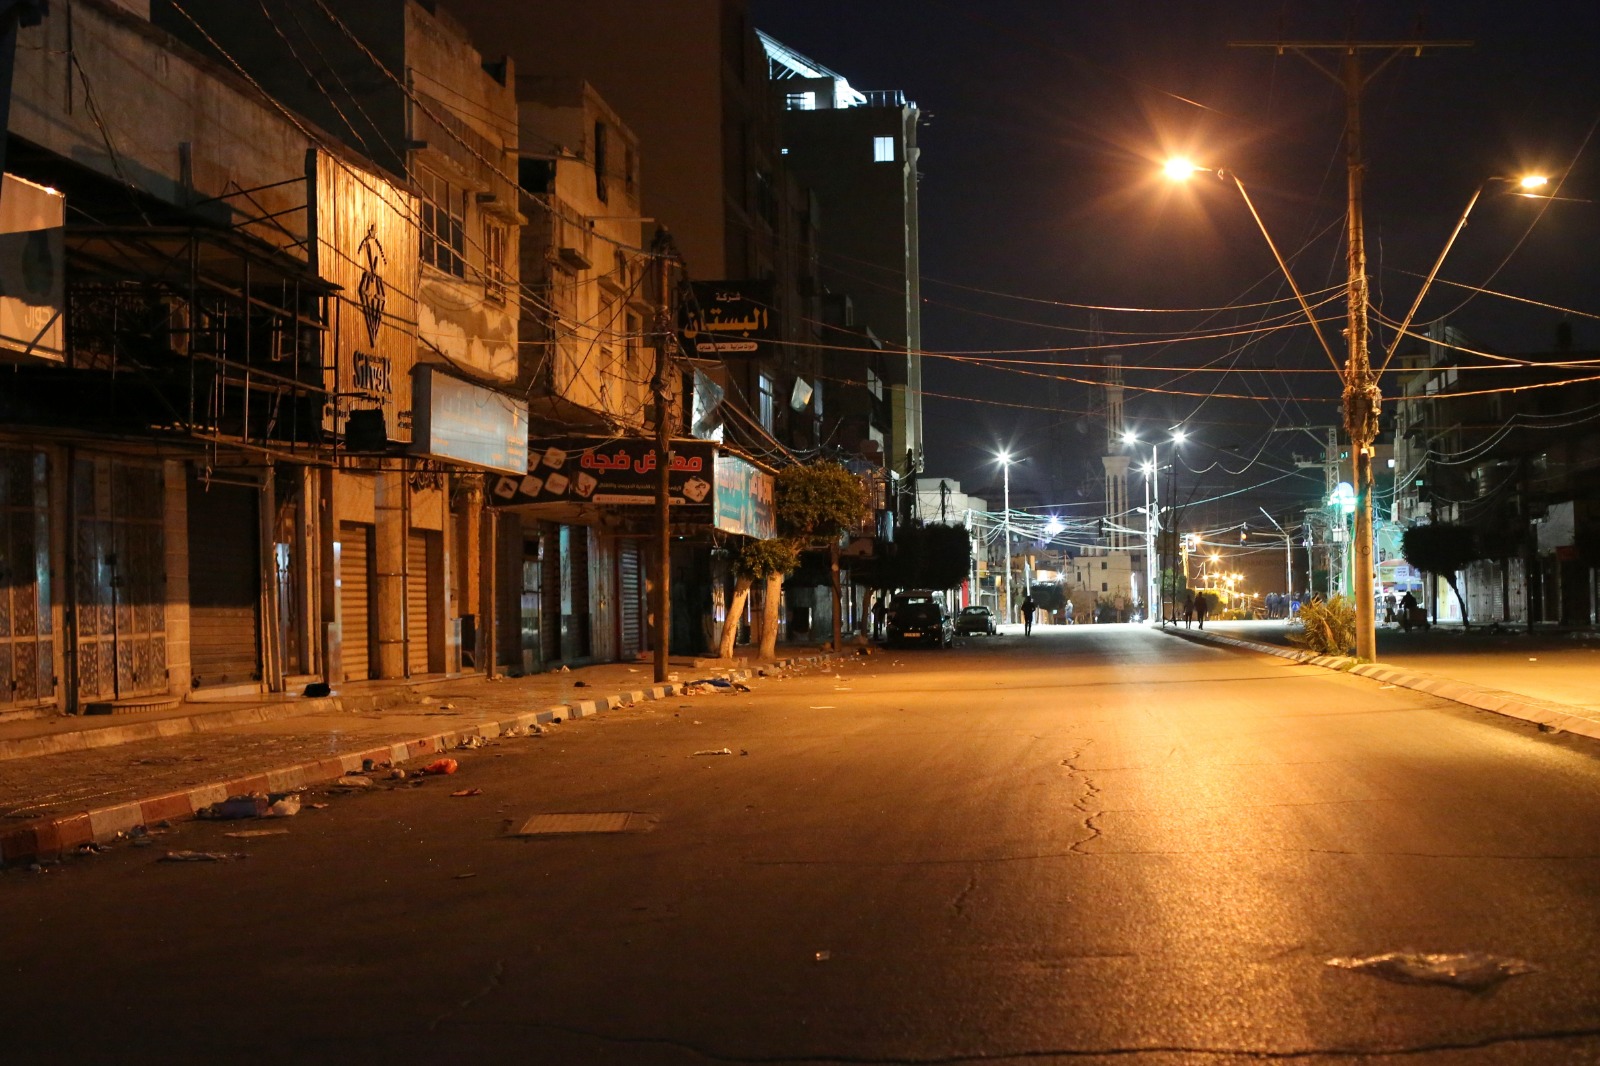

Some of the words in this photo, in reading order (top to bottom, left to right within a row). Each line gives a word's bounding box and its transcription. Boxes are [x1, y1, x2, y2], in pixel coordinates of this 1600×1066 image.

[715, 291, 741, 303] شركة
[684, 307, 768, 339] البستان
[581, 448, 631, 474] ضجة
[634, 449, 703, 474] معض
